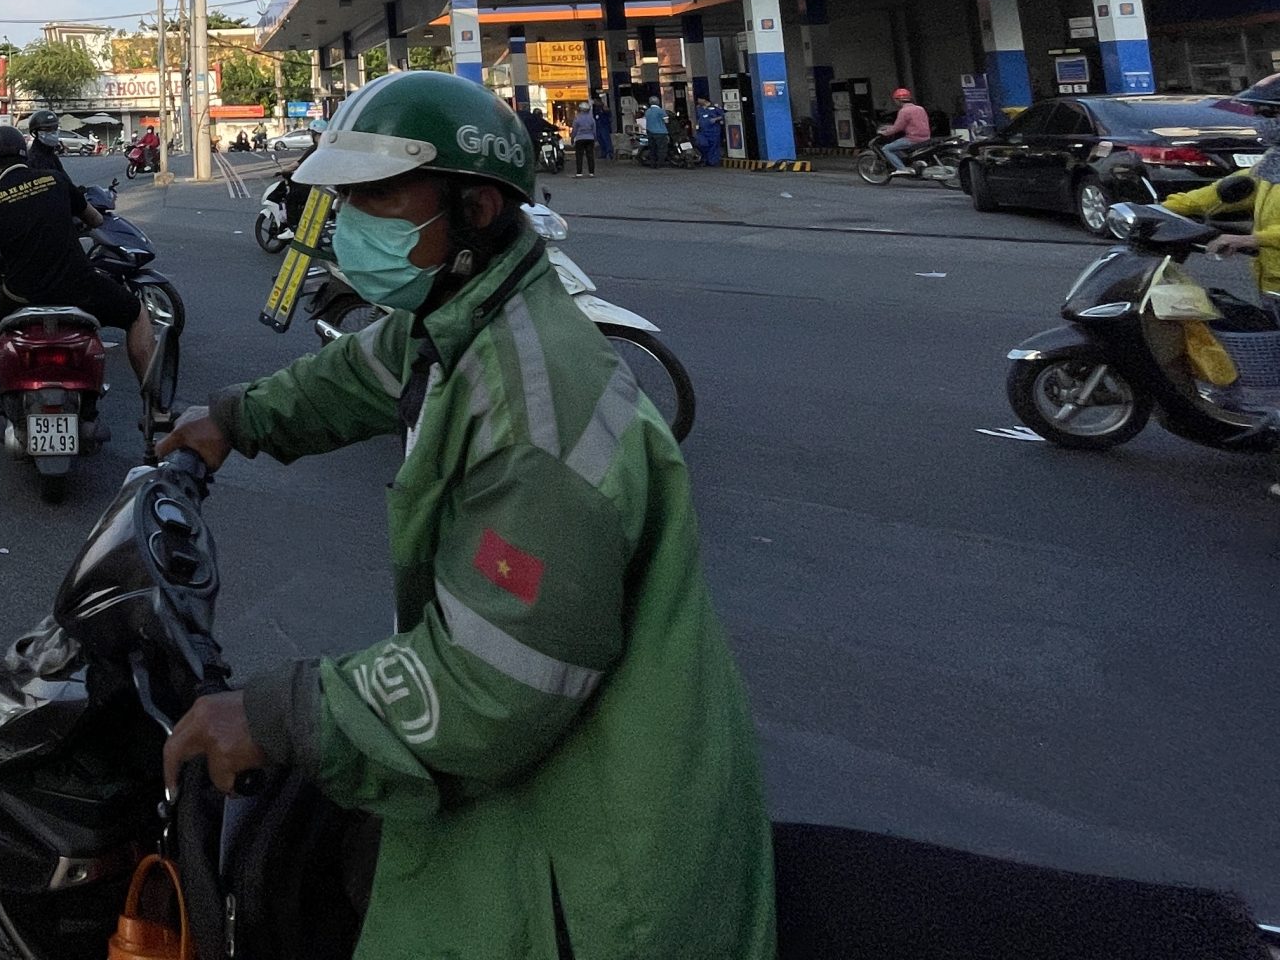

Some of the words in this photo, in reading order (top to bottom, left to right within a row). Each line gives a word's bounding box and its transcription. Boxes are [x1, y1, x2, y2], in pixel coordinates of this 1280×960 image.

[105, 75, 157, 97] THỐNG
[456, 125, 526, 168] Grab
[35, 417, 69, 434] 59-E1
